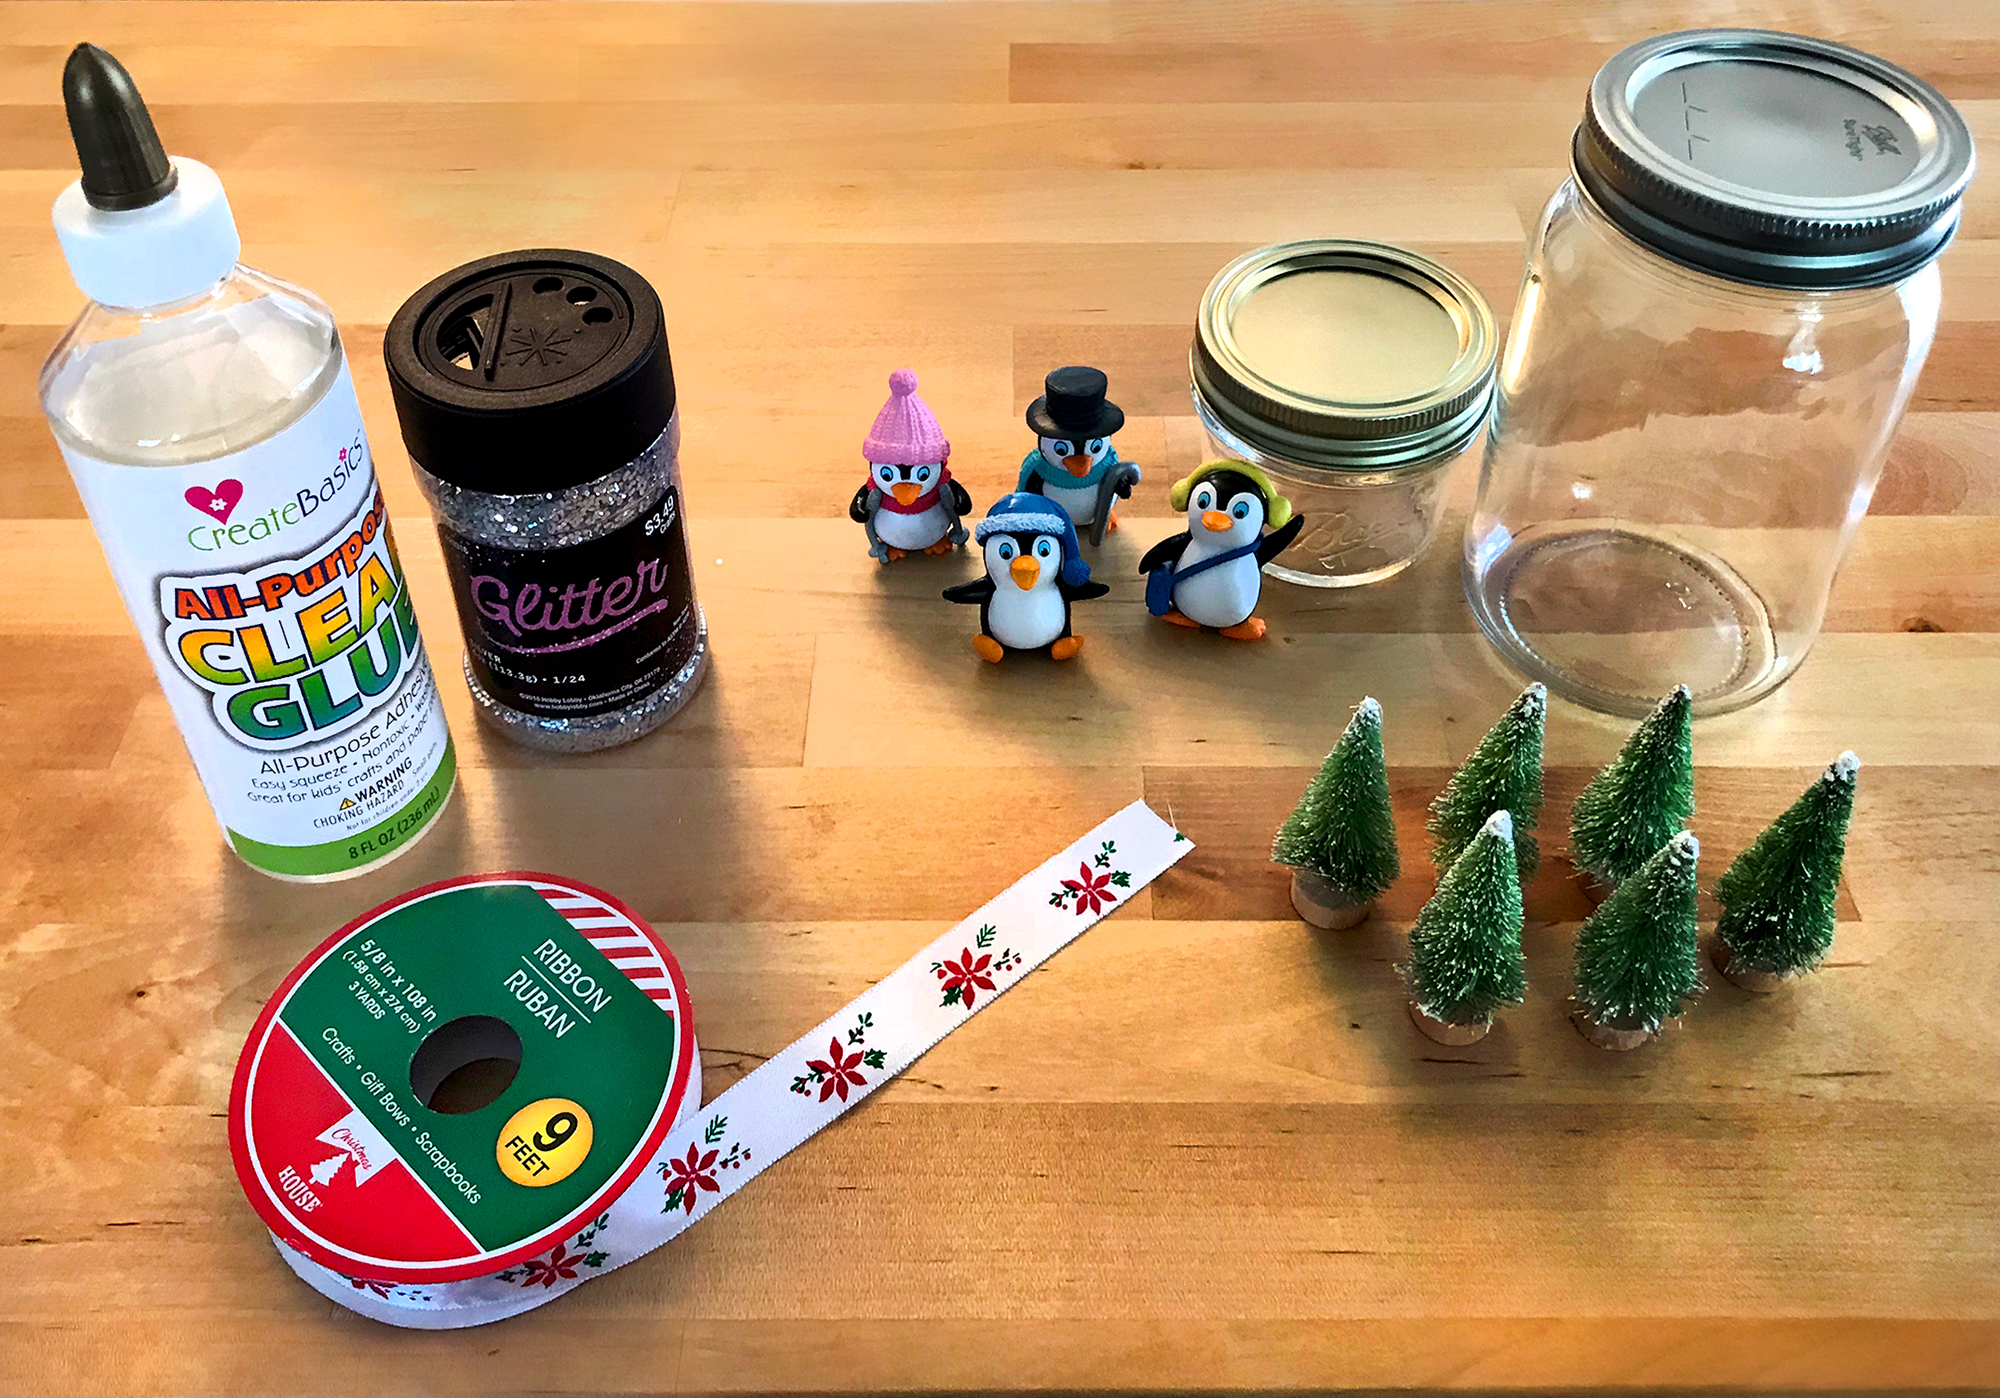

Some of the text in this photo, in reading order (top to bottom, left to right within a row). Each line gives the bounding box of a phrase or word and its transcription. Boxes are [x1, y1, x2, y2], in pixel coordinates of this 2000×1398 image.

[645, 495, 674, 536] $3.49
[470, 559, 668, 637] Glitter
[541, 696, 561, 704] Hobby
[563, 696, 583, 705] Lobby
[588, 688, 620, 701] Oklahoma
[634, 678, 643, 686] OK
[553, 675, 585, 684] 1/24
[608, 694, 626, 703] Made
[626, 690, 633, 698] in
[634, 682, 650, 693] China
[247, 791, 284, 803] Great
[287, 792, 307, 803] for
[347, 764, 382, 787] crafts
[385, 741, 406, 765] and
[251, 720, 410, 791] Easy squeeze Nontoxic
[261, 725, 380, 774] All-Purpose
[355, 757, 412, 802] WARNING
[313, 805, 364, 828] CHOKING
[366, 780, 404, 811] HAZARD
[346, 822, 360, 831] Not
[361, 817, 372, 825] for
[348, 786, 440, 859] 8 FL OZ (236 mL)
[342, 950, 421, 1034] (1.58 cm x 274 cm)
[360, 939, 437, 1022] 5/8 in x 108 in
[533, 938, 612, 1013] RIBBON
[348, 980, 386, 1020] 3 YARDS
[503, 968, 576, 1038] RUBAN
[322, 1027, 482, 1205] Crafts Gift Bows Scrapbooks
[533, 1111, 578, 1152] 9
[331, 1128, 372, 1170] Christmas
[505, 1135, 550, 1177] FEET
[278, 1165, 321, 1212] HOUSE
